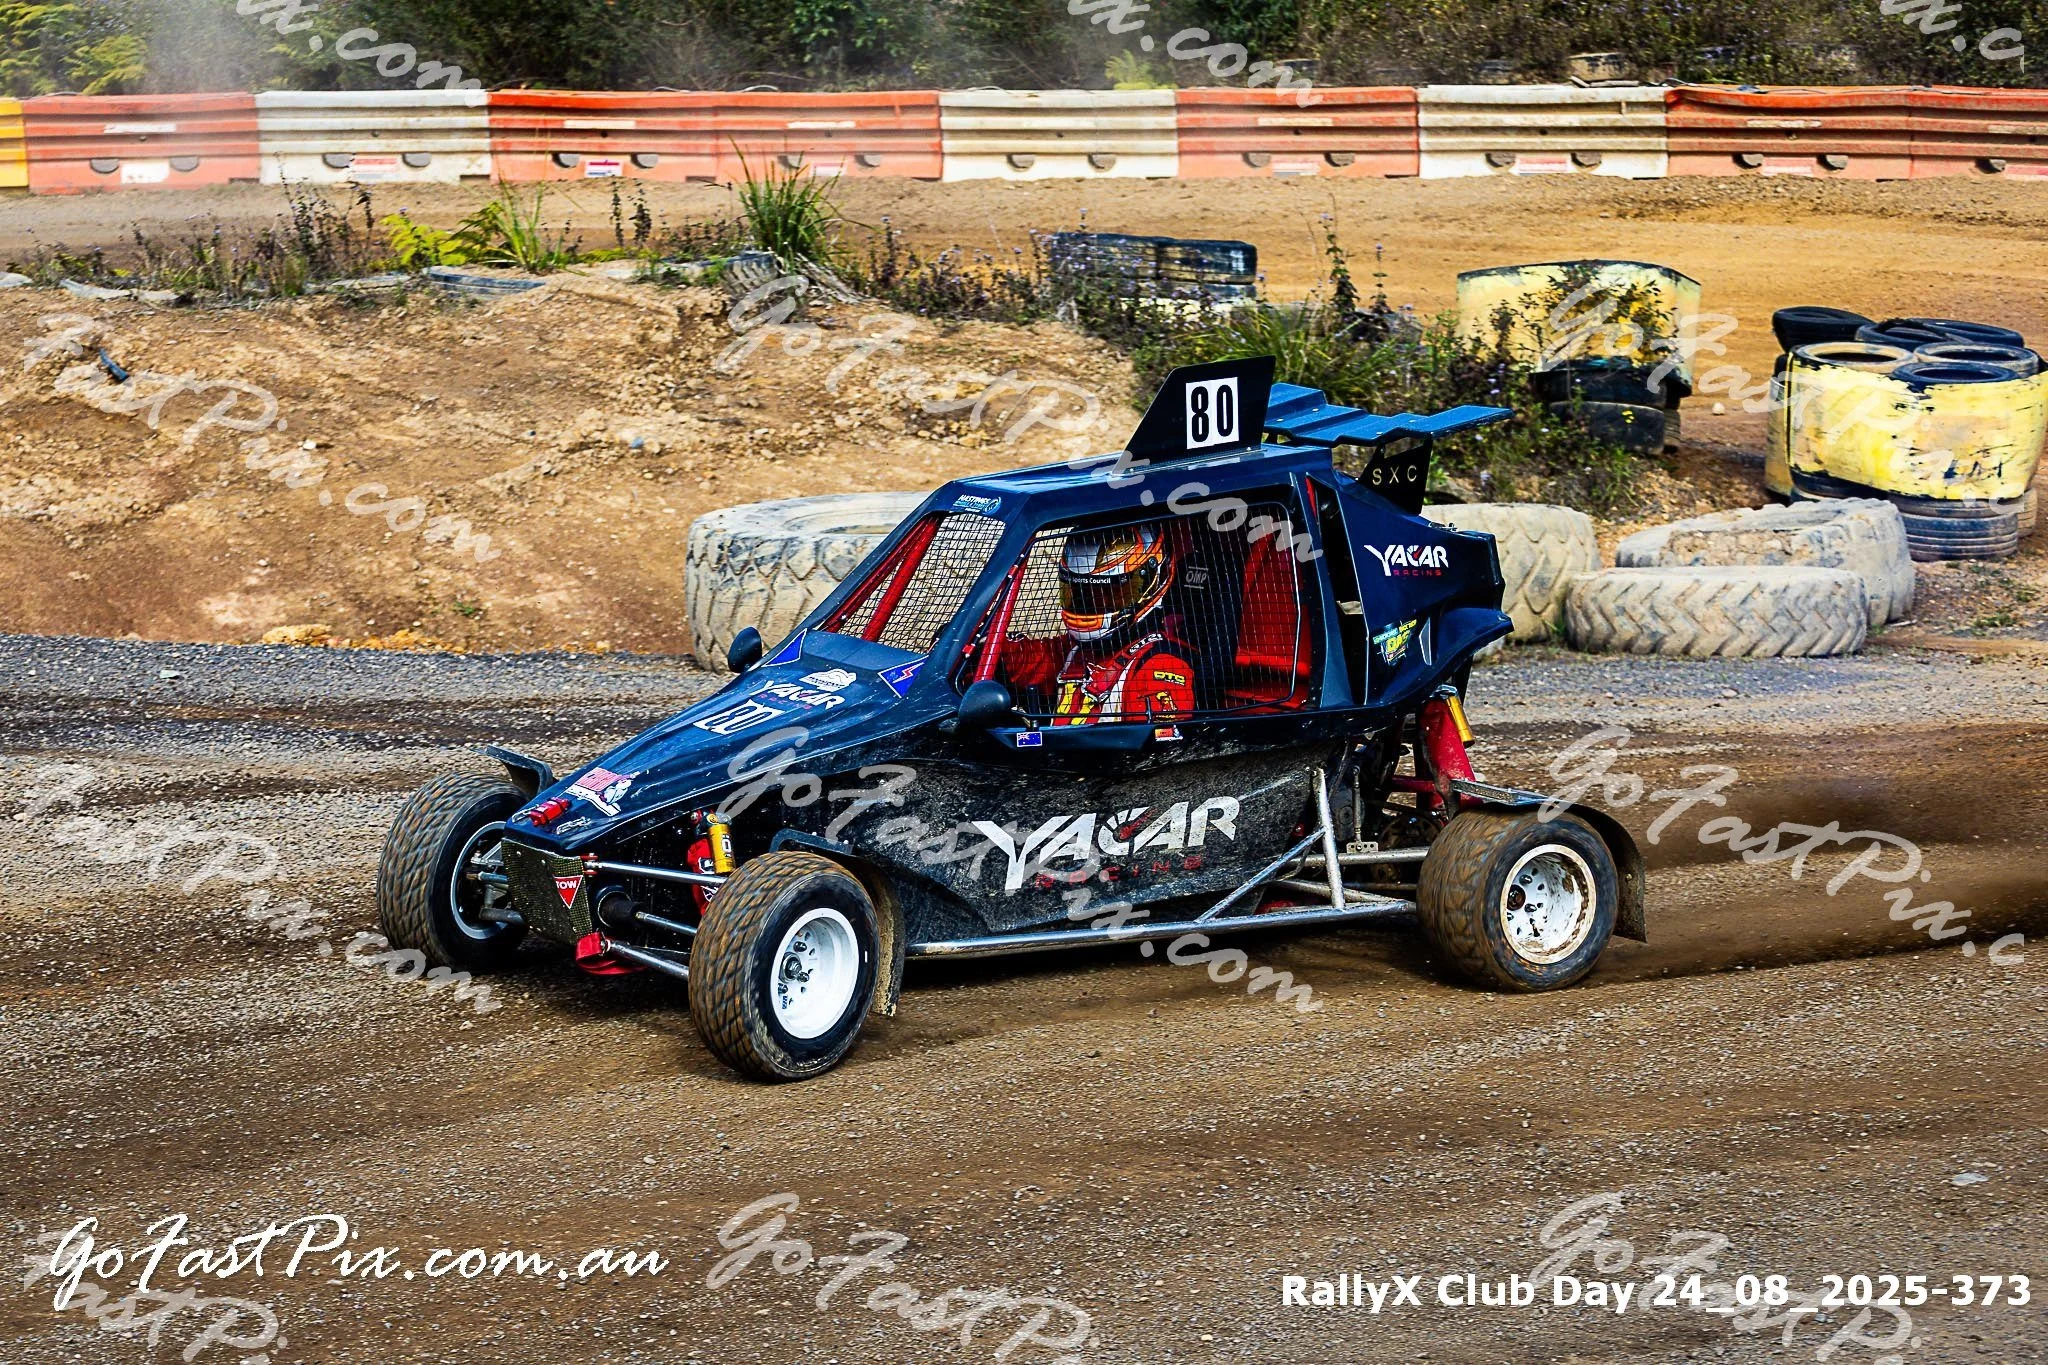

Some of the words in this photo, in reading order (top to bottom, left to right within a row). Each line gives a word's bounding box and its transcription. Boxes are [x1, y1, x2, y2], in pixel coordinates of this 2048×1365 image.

[1190, 384, 1234, 443] 80
[1363, 544, 1449, 577] YACAR
[1392, 569, 1442, 577] RACING
[749, 680, 845, 710] YACAR
[971, 796, 1240, 892] YACAR
[556, 880, 577, 889] TOW
